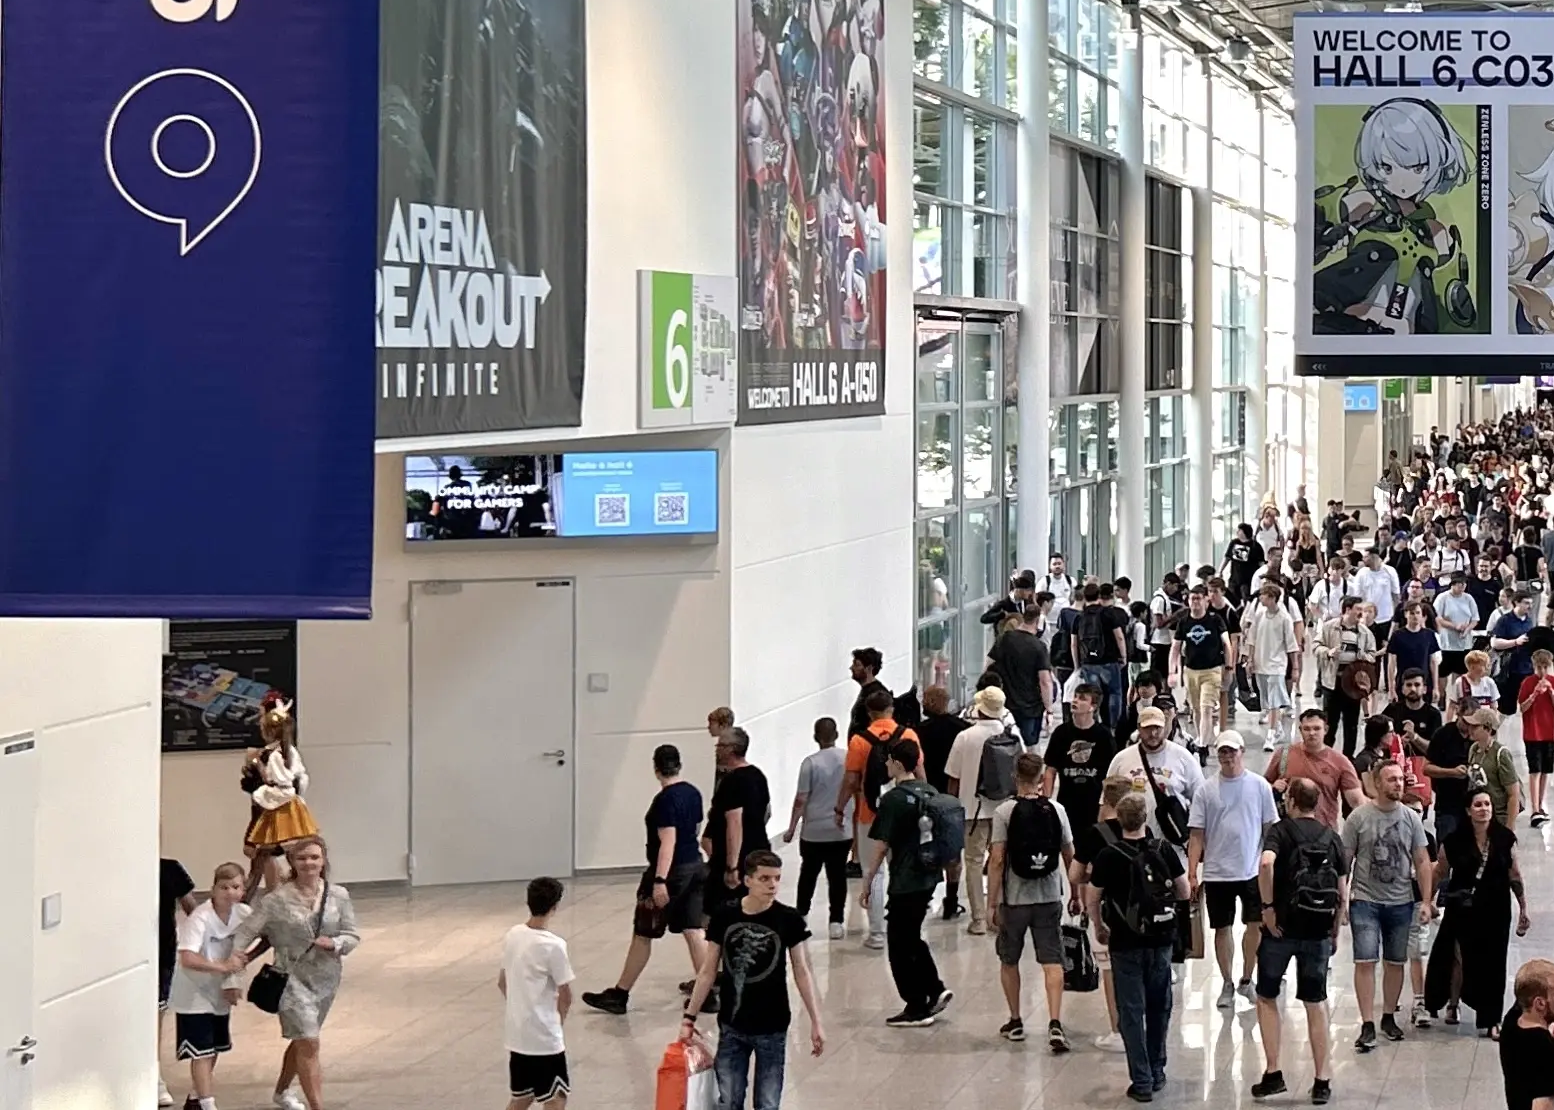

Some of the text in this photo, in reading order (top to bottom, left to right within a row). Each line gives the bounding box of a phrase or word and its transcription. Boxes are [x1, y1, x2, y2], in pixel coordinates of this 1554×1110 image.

[1313, 30, 1511, 51] WELCOME TO
[1313, 54, 1421, 87] HALL
[1481, 108, 1490, 210] ZENLESS ZONE ZERO
[384, 197, 496, 269] ARENA
[666, 309, 689, 409] 6
[382, 362, 499, 398] INFINITE
[792, 361, 828, 406] HALL
[828, 361, 838, 404] 6
[841, 361, 877, 404] A-050
[447, 497, 524, 509] FOR GAMERS
